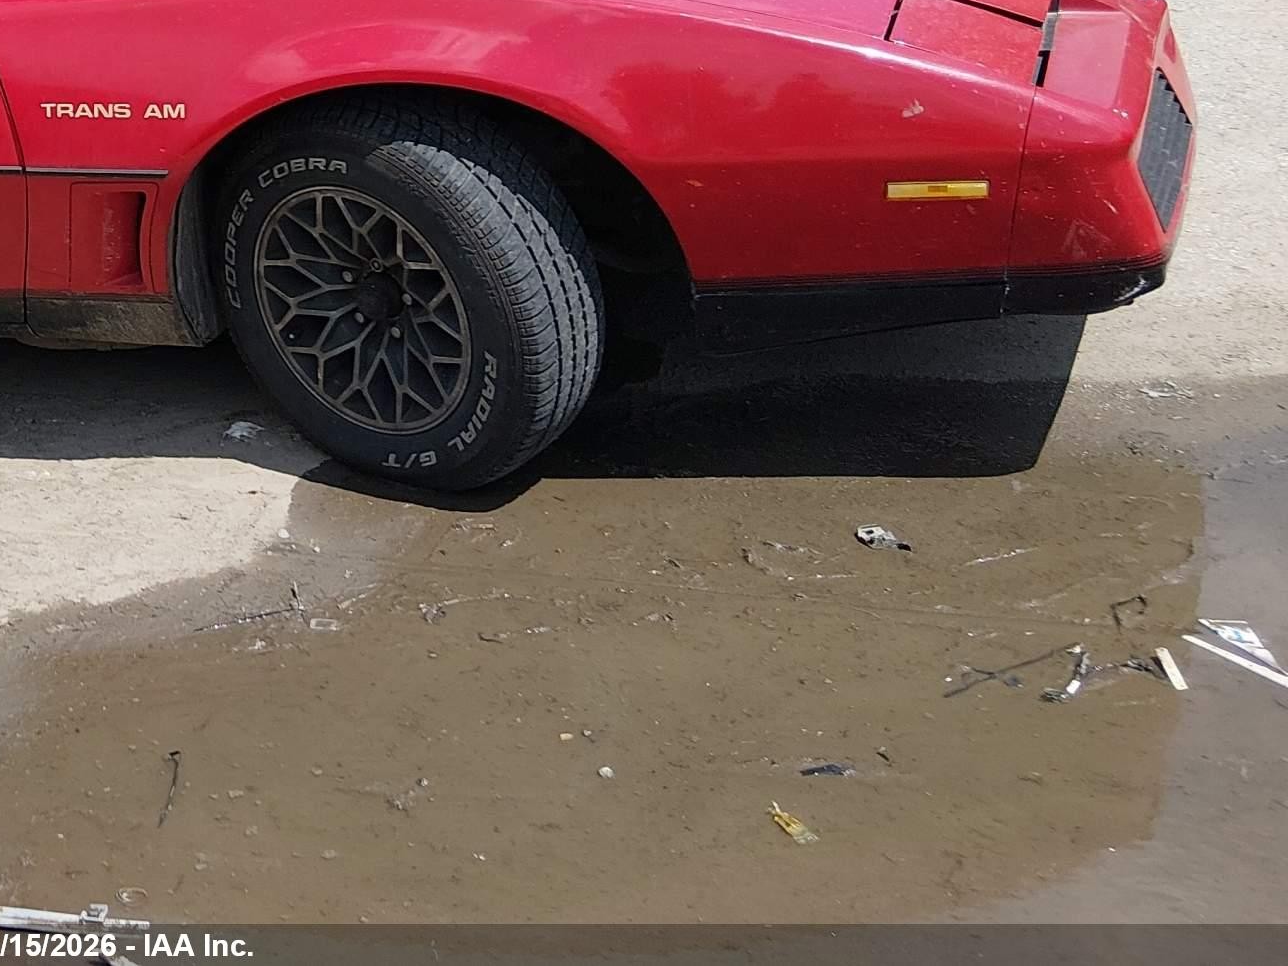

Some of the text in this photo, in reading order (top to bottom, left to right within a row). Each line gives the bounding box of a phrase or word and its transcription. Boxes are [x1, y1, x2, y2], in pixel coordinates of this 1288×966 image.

[40, 102, 186, 119] TRANS AM
[224, 157, 348, 309] COOPER COBRA
[381, 350, 498, 469] RADIAL G/T
